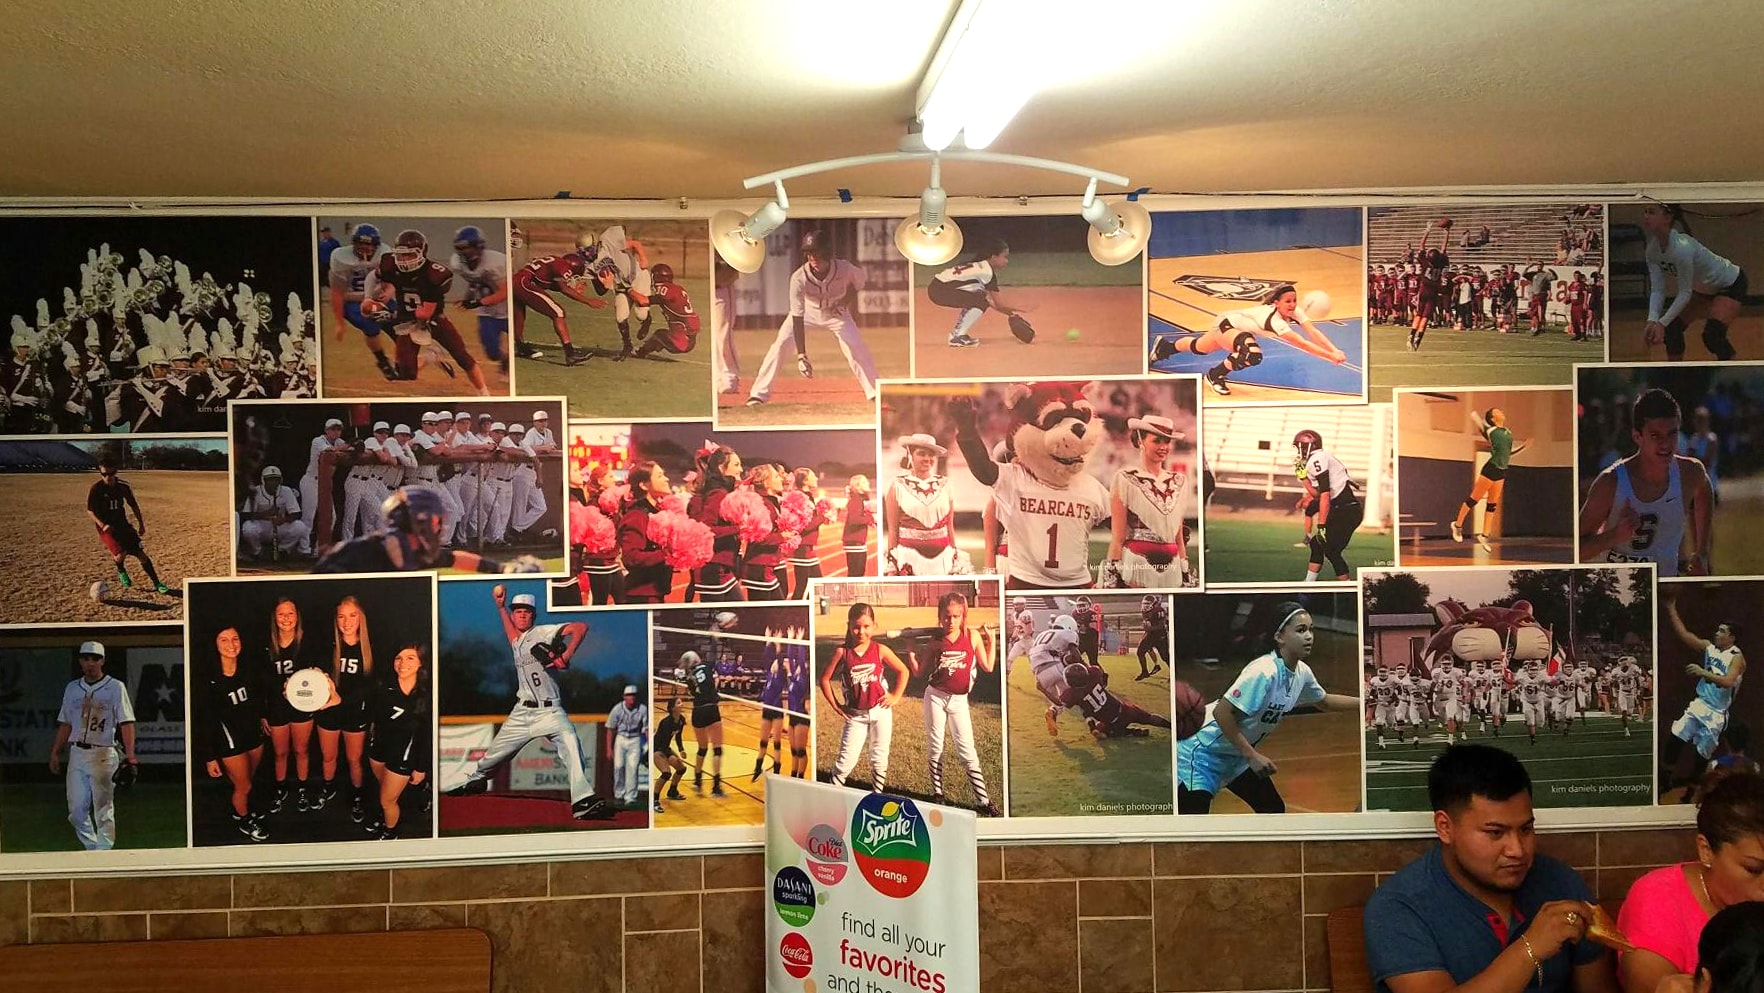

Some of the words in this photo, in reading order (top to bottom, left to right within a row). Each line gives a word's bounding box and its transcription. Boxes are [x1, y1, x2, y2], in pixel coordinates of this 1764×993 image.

[1313, 460, 1322, 473] 5
[1019, 496, 1092, 521] BEARCATS
[1044, 522, 1060, 569] 1
[275, 659, 294, 675] 12
[340, 657, 359, 674] 15
[531, 672, 542, 688] 6
[695, 669, 707, 684] 5
[228, 686, 249, 705] 10
[1083, 683, 1108, 714] 16
[390, 706, 405, 720] 7
[90, 717, 106, 732] 24
[1551, 784, 1566, 793] kim
[1568, 784, 1597, 793] daniels
[1599, 783, 1651, 794] photography
[1080, 803, 1095, 812] kim
[1096, 802, 1125, 812] daniels
[1126, 802, 1173, 813] photograph
[864, 813, 911, 847] Sprite
[808, 836, 843, 861] Coke
[817, 872, 836, 883] vanilla
[874, 868, 908, 884] orange
[777, 876, 812, 895] DASANI
[782, 891, 808, 904] sparkling
[841, 911, 876, 939] find
[881, 923, 900, 945] all
[905, 933, 946, 959] your
[840, 938, 946, 993] favorites
[827, 974, 860, 993] and
[866, 980, 893, 993] th
